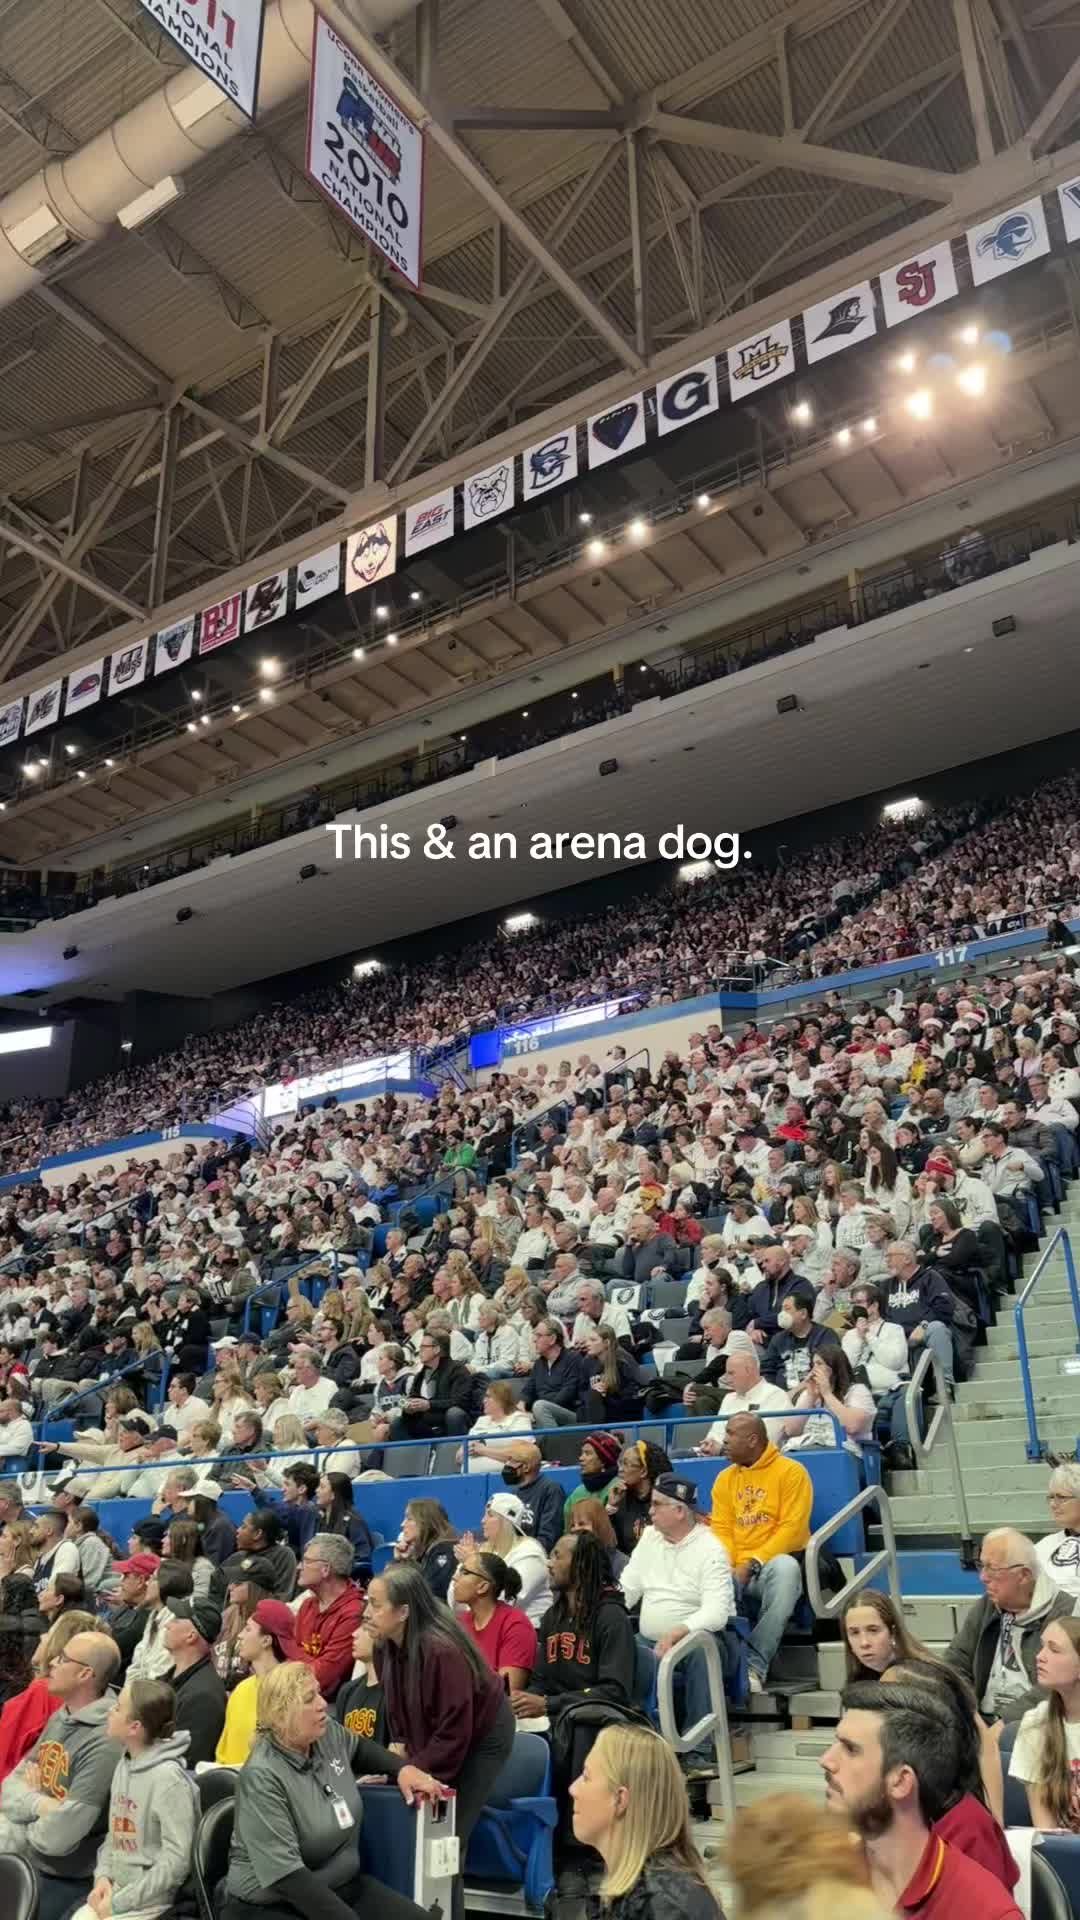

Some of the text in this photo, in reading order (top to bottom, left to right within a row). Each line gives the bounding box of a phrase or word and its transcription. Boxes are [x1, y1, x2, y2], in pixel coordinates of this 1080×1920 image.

[167, 0, 233, 72] IONAL
[184, 0, 236, 50] 11
[324, 121, 409, 229] 2010
[321, 172, 409, 272] CHAMPIONS
[329, 160, 403, 249] NATIONAL
[895, 260, 937, 306] SJ
[661, 372, 711, 421] G
[410, 508, 453, 536] EAST
[415, 503, 446, 526] BIG
[936, 946, 968, 967] 117
[514, 1037, 540, 1055] 116
[344, 1706, 377, 1738] USC
